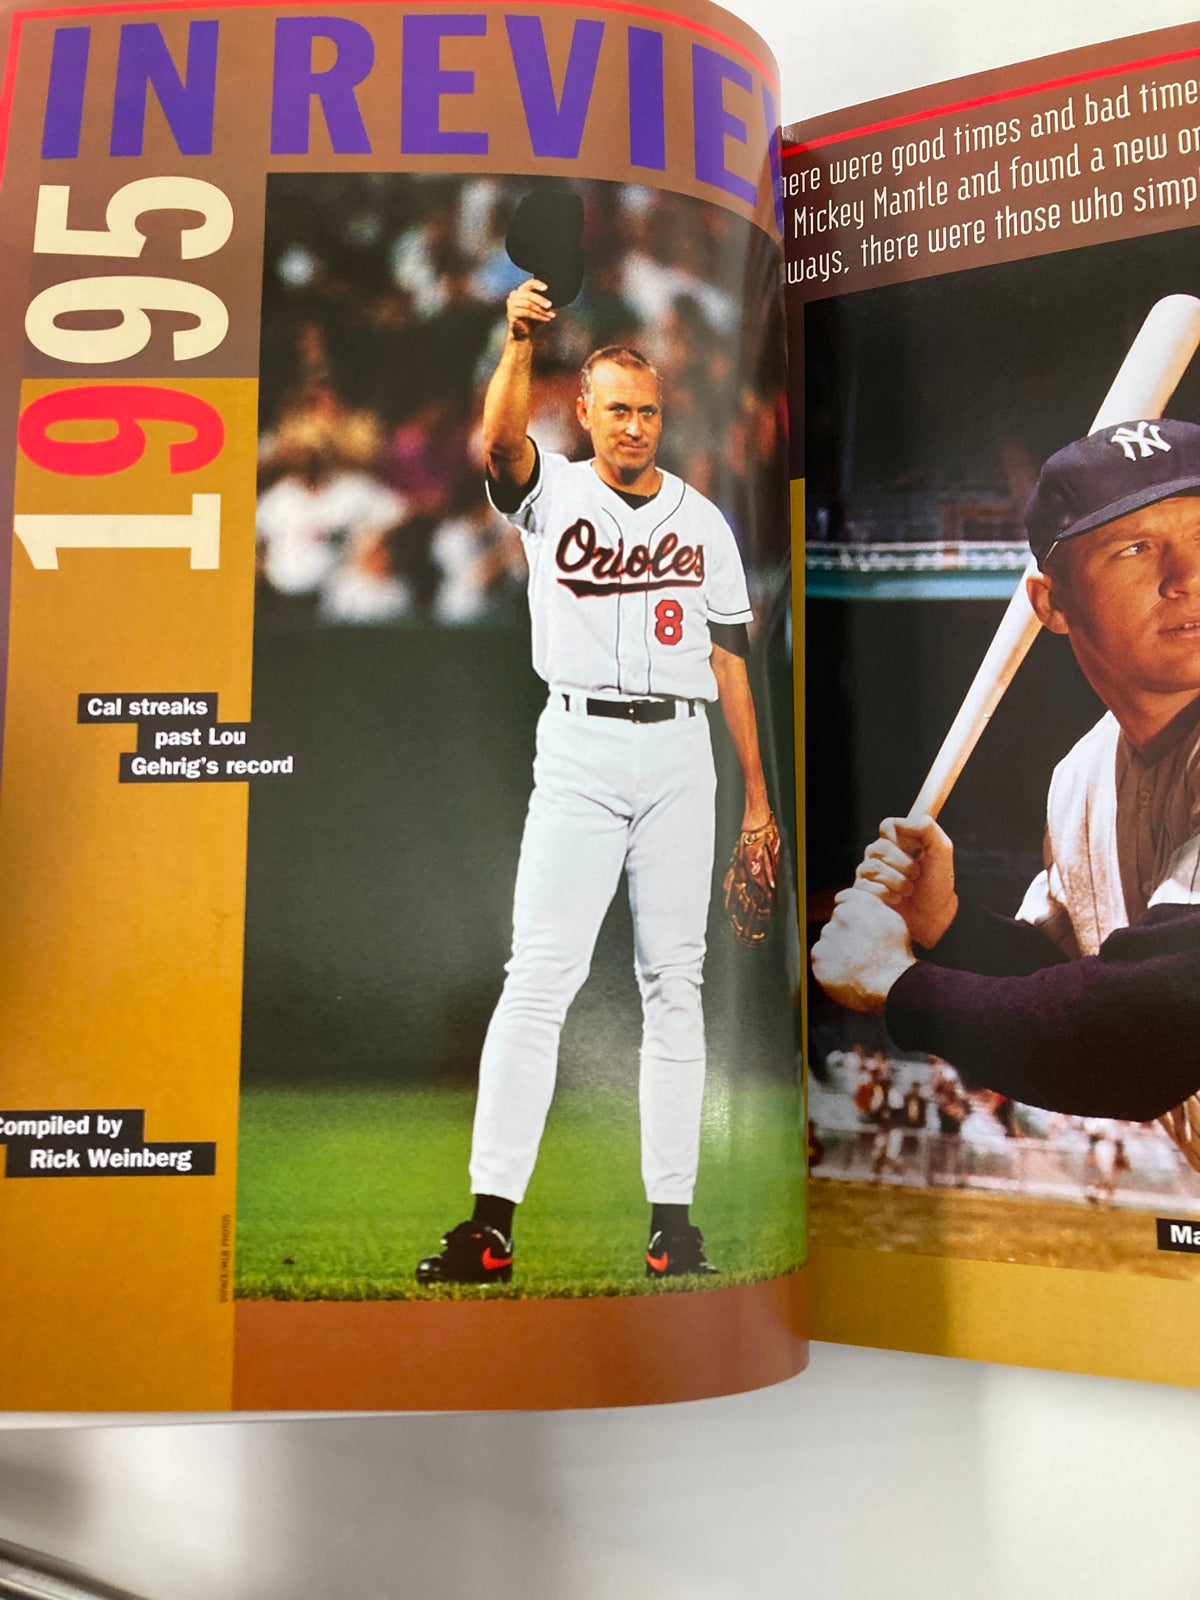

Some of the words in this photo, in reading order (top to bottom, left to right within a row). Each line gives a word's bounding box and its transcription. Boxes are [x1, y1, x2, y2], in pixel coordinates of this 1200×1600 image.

[40, 20, 220, 160] IN
[830, 150, 883, 185] were
[892, 127, 945, 175] good
[954, 118, 1021, 156] times
[1030, 98, 1075, 138] and
[1084, 85, 1131, 126] bad
[1139, 80, 1200, 113] time
[794, 198, 864, 239] Mickey
[873, 174, 948, 220] Mantle
[957, 162, 1001, 201] and
[1009, 144, 1081, 190] found
[1090, 147, 1105, 172] a
[1113, 132, 1168, 167] new
[861, 232, 919, 268] there
[928, 217, 986, 253] were
[995, 202, 1061, 240] those
[1071, 189, 1123, 225] who
[1133, 168, 1200, 212] simp
[12, 175, 235, 571] 1995
[556, 517, 705, 588] Orioles
[654, 599, 684, 646] 8
[87, 697, 122, 716] Cal
[128, 697, 208, 716] streaks
[131, 756, 219, 778] Gehrig's
[226, 756, 293, 774] record
[155, 728, 201, 749] past
[208, 727, 246, 746] Lou
[97, 1115, 123, 1139] by
[29, 1149, 80, 1169] Rick
[87, 1148, 193, 1171] Weinberg
